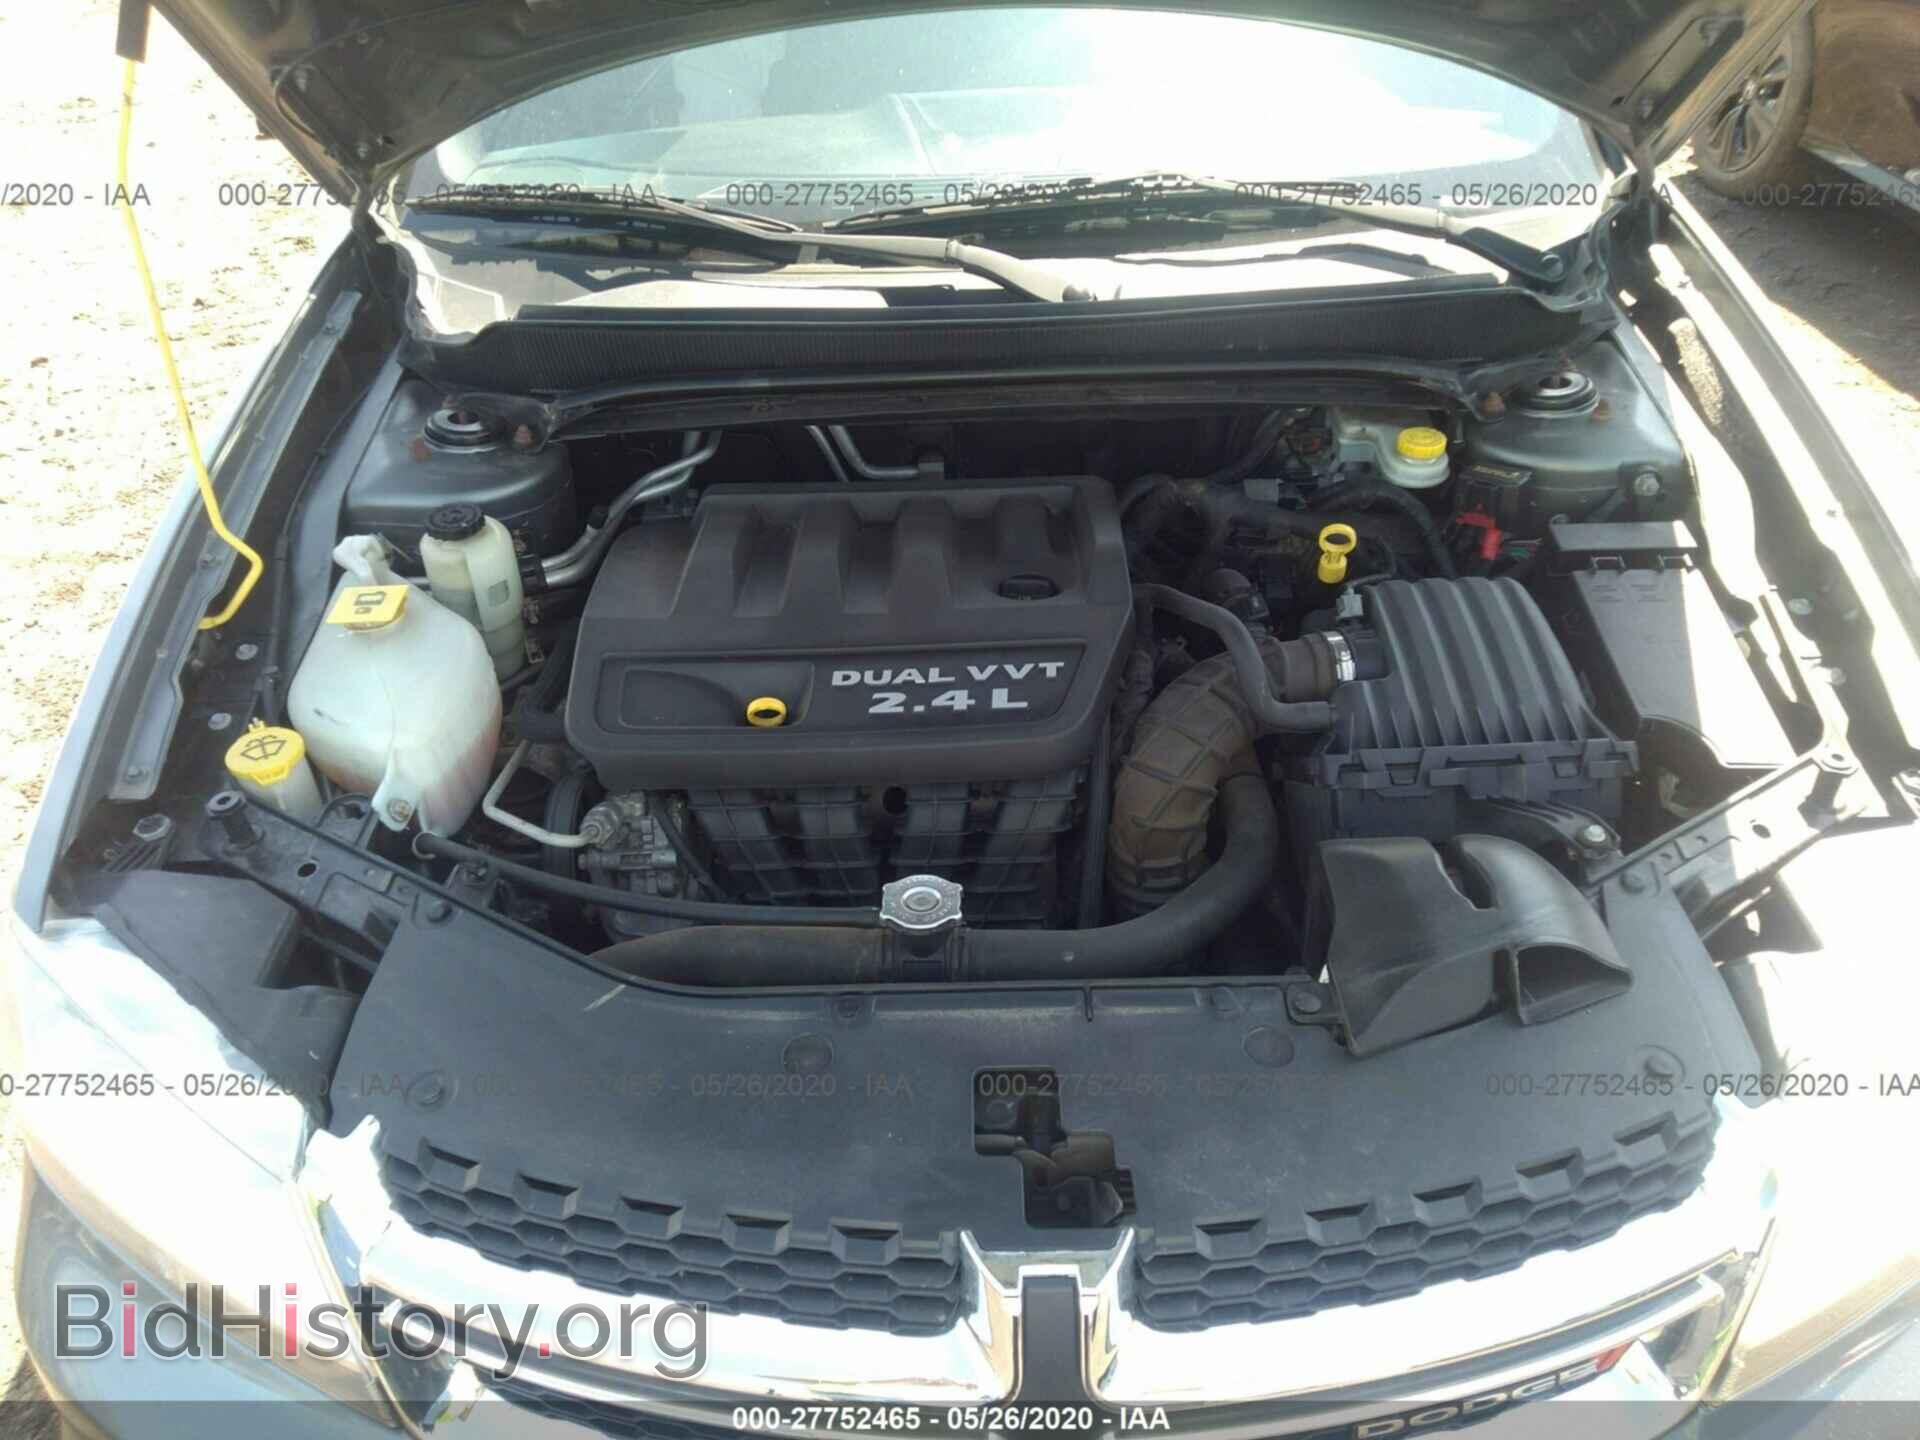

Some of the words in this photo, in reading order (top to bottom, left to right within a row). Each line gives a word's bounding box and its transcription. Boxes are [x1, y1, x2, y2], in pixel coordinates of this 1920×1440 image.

[831, 667, 956, 687] DUAL
[967, 662, 1065, 681] VVT
[1356, 1357, 1598, 1440] DODGE
